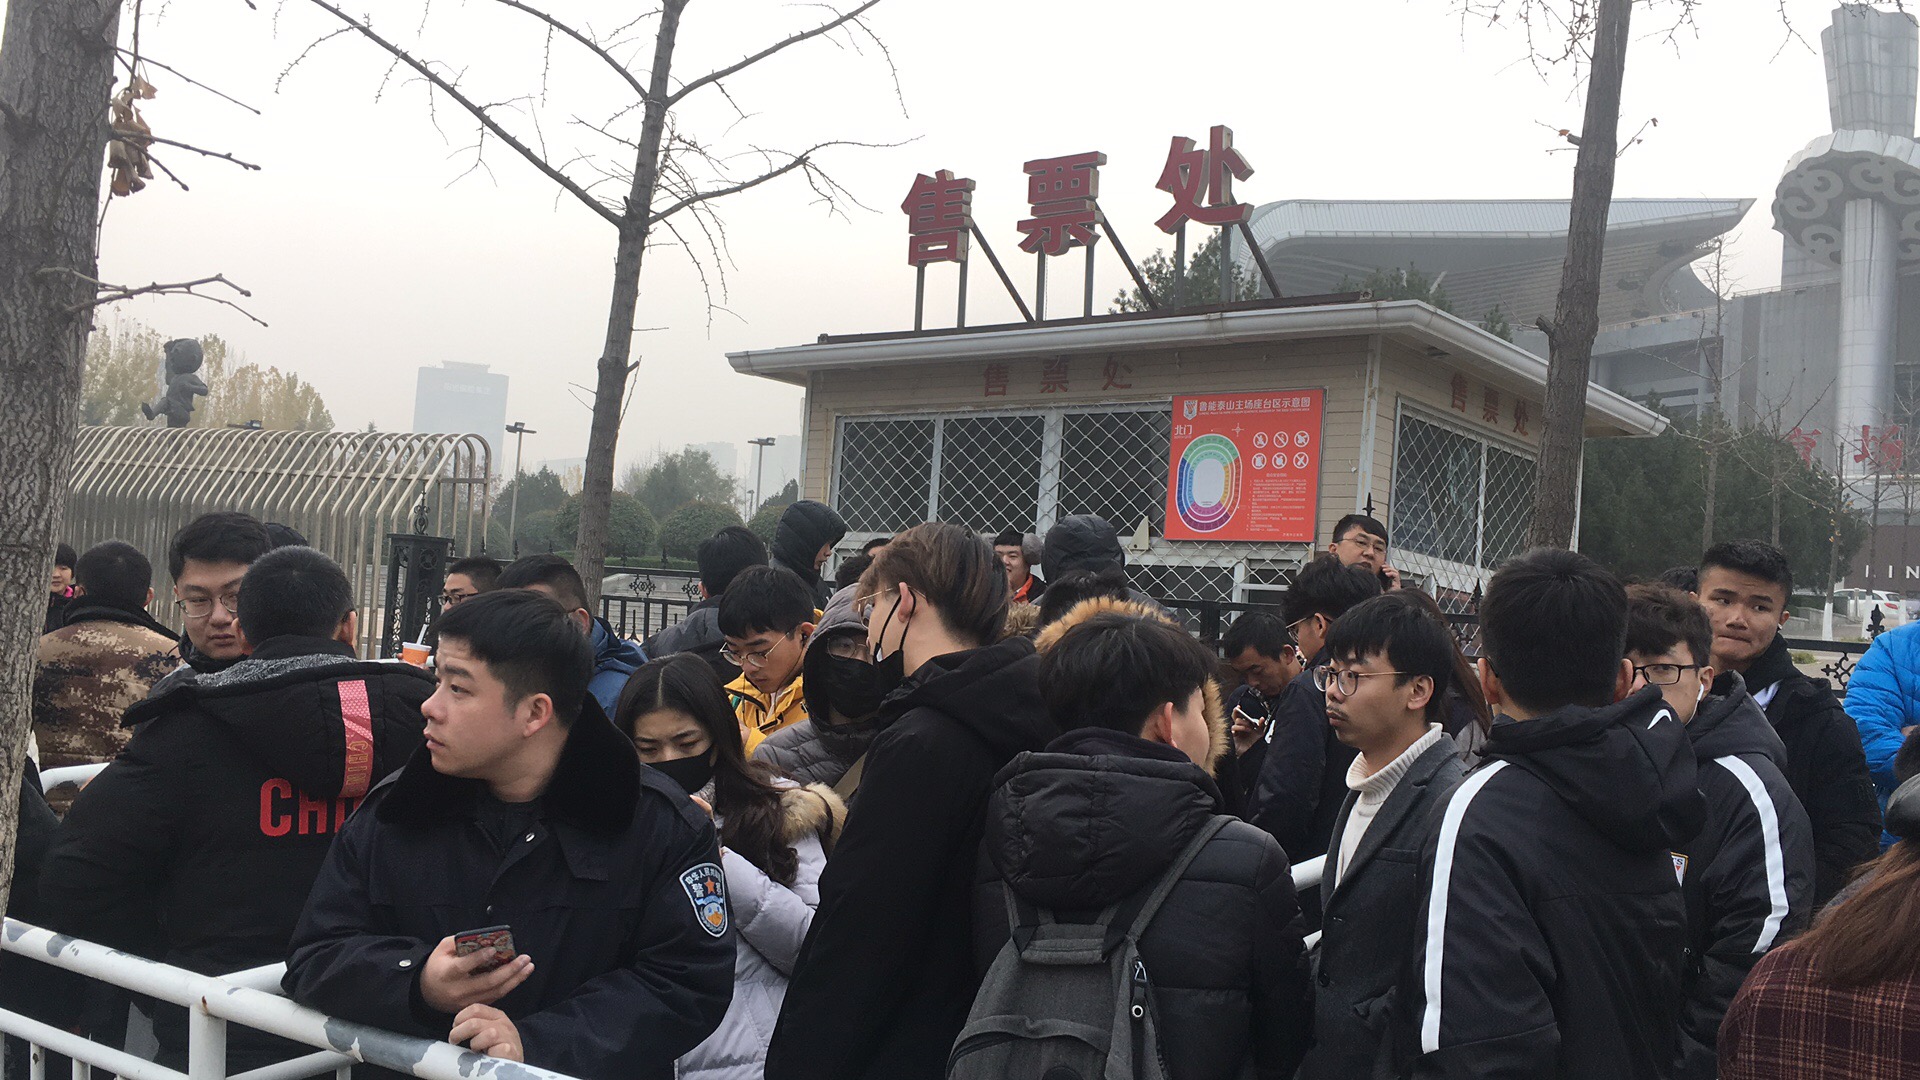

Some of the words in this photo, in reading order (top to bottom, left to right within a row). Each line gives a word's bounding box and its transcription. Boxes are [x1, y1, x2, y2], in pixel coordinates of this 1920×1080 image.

[901, 125, 1255, 266] 售票处
[984, 352, 1133, 397] 售票处
[1450, 371, 1529, 436] 售票处
[1174, 424, 1193, 436] 北门
[260, 778, 363, 837] CHI
